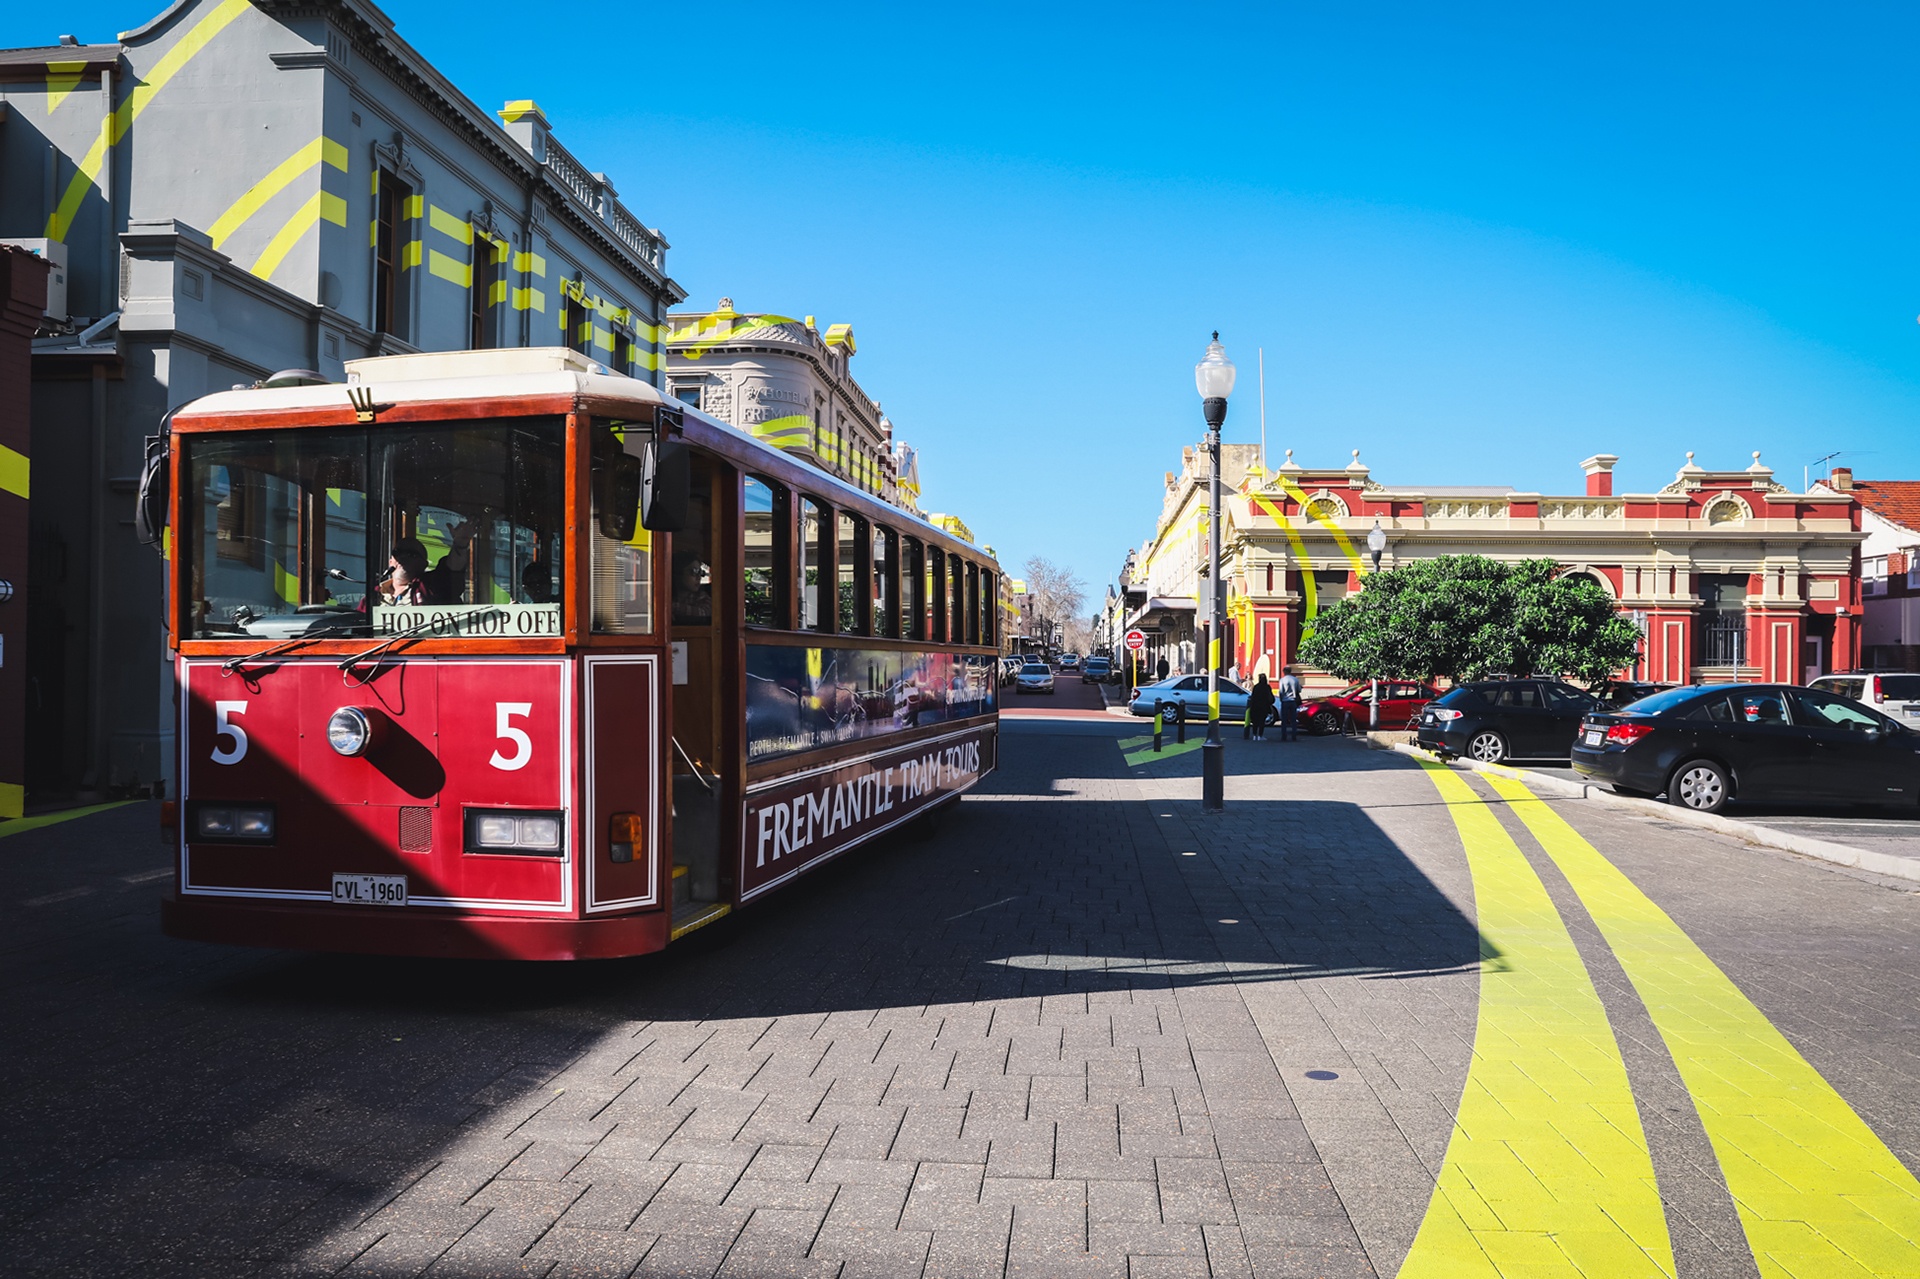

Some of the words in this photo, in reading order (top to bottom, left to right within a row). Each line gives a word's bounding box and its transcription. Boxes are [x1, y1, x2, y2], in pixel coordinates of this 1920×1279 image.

[764, 388, 804, 404] HOTEL
[381, 613, 425, 635] HOP
[430, 612, 461, 634] ON
[467, 612, 511, 634] HOP
[516, 610, 559, 634] OFF
[210, 700, 249, 765] 5
[488, 702, 533, 771] 5
[749, 739, 772, 757] PERTH
[779, 732, 815, 751] FREMANTLE
[756, 768, 894, 868] FREMANTLE
[900, 751, 942, 803] TRAM
[945, 739, 980, 784] TOURS
